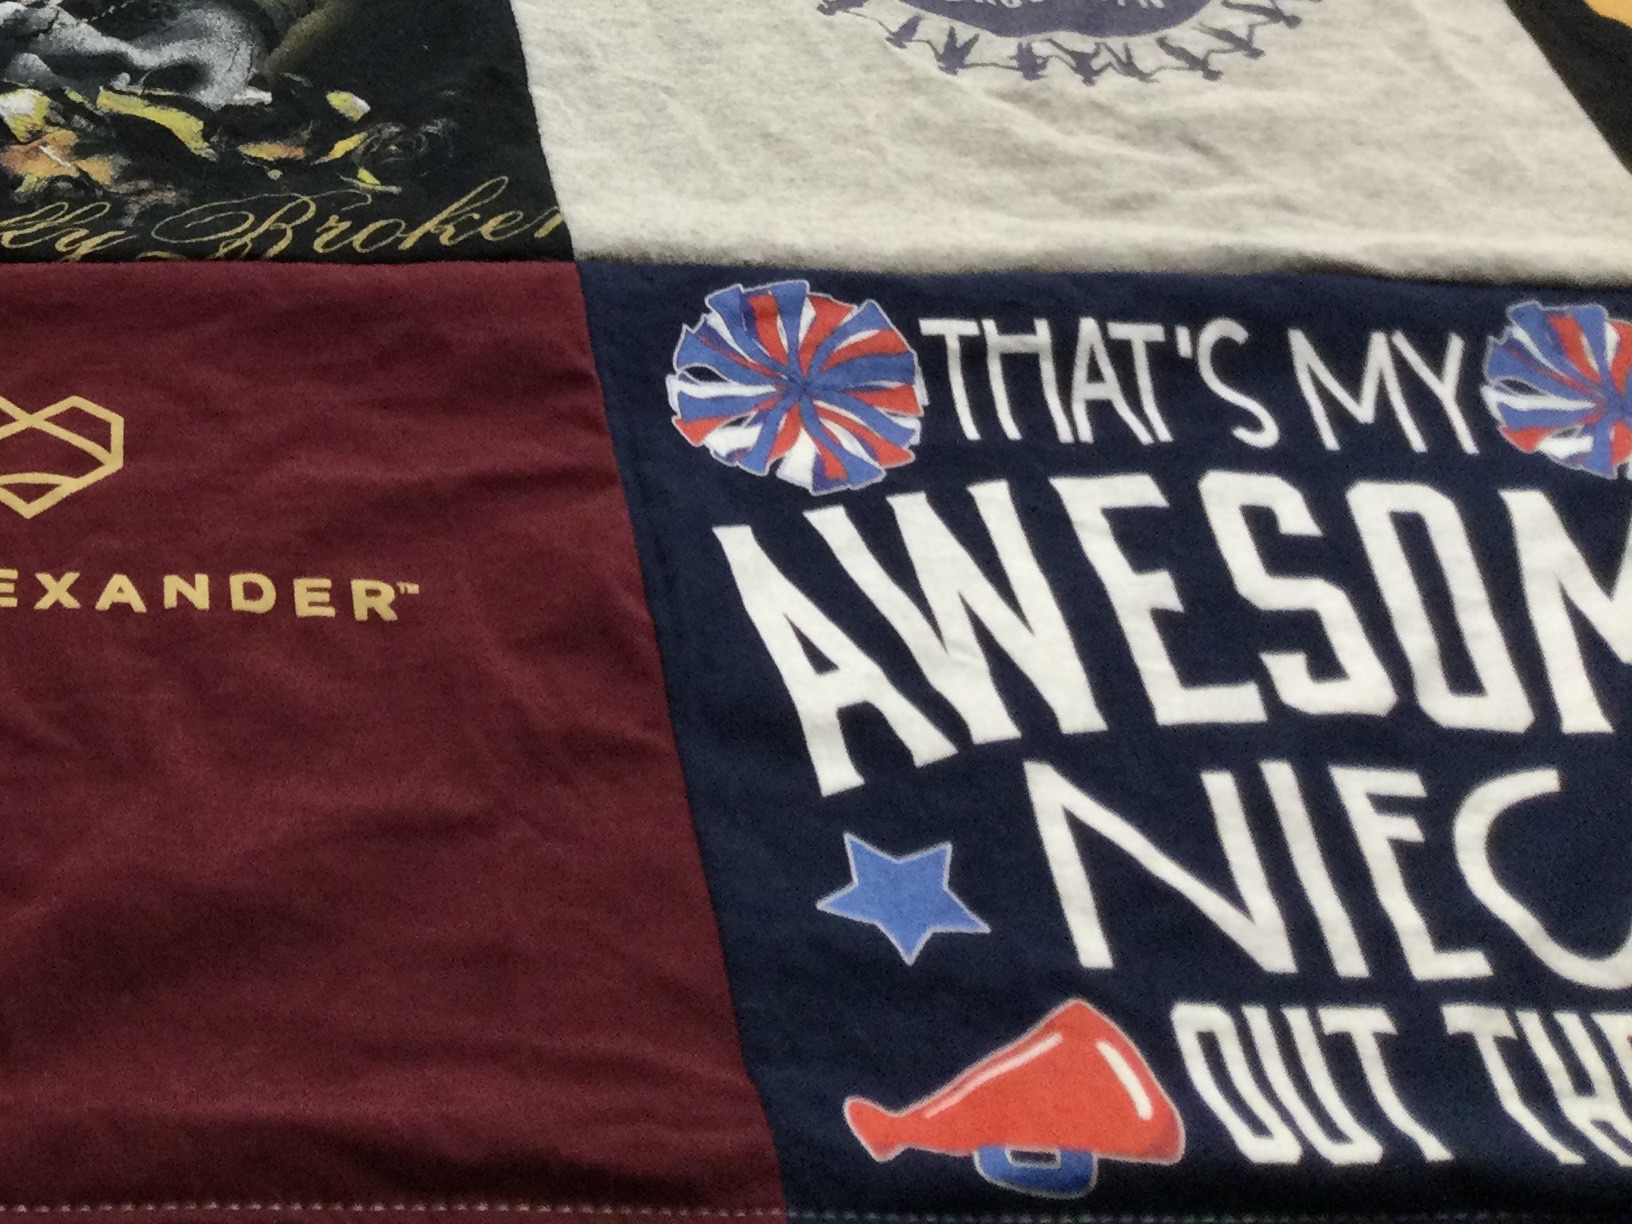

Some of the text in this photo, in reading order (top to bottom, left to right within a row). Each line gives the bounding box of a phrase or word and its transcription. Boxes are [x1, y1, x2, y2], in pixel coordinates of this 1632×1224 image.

[917, 317, 1481, 454] THAT'S MY
[1170, 1001, 1455, 1165] OUT
